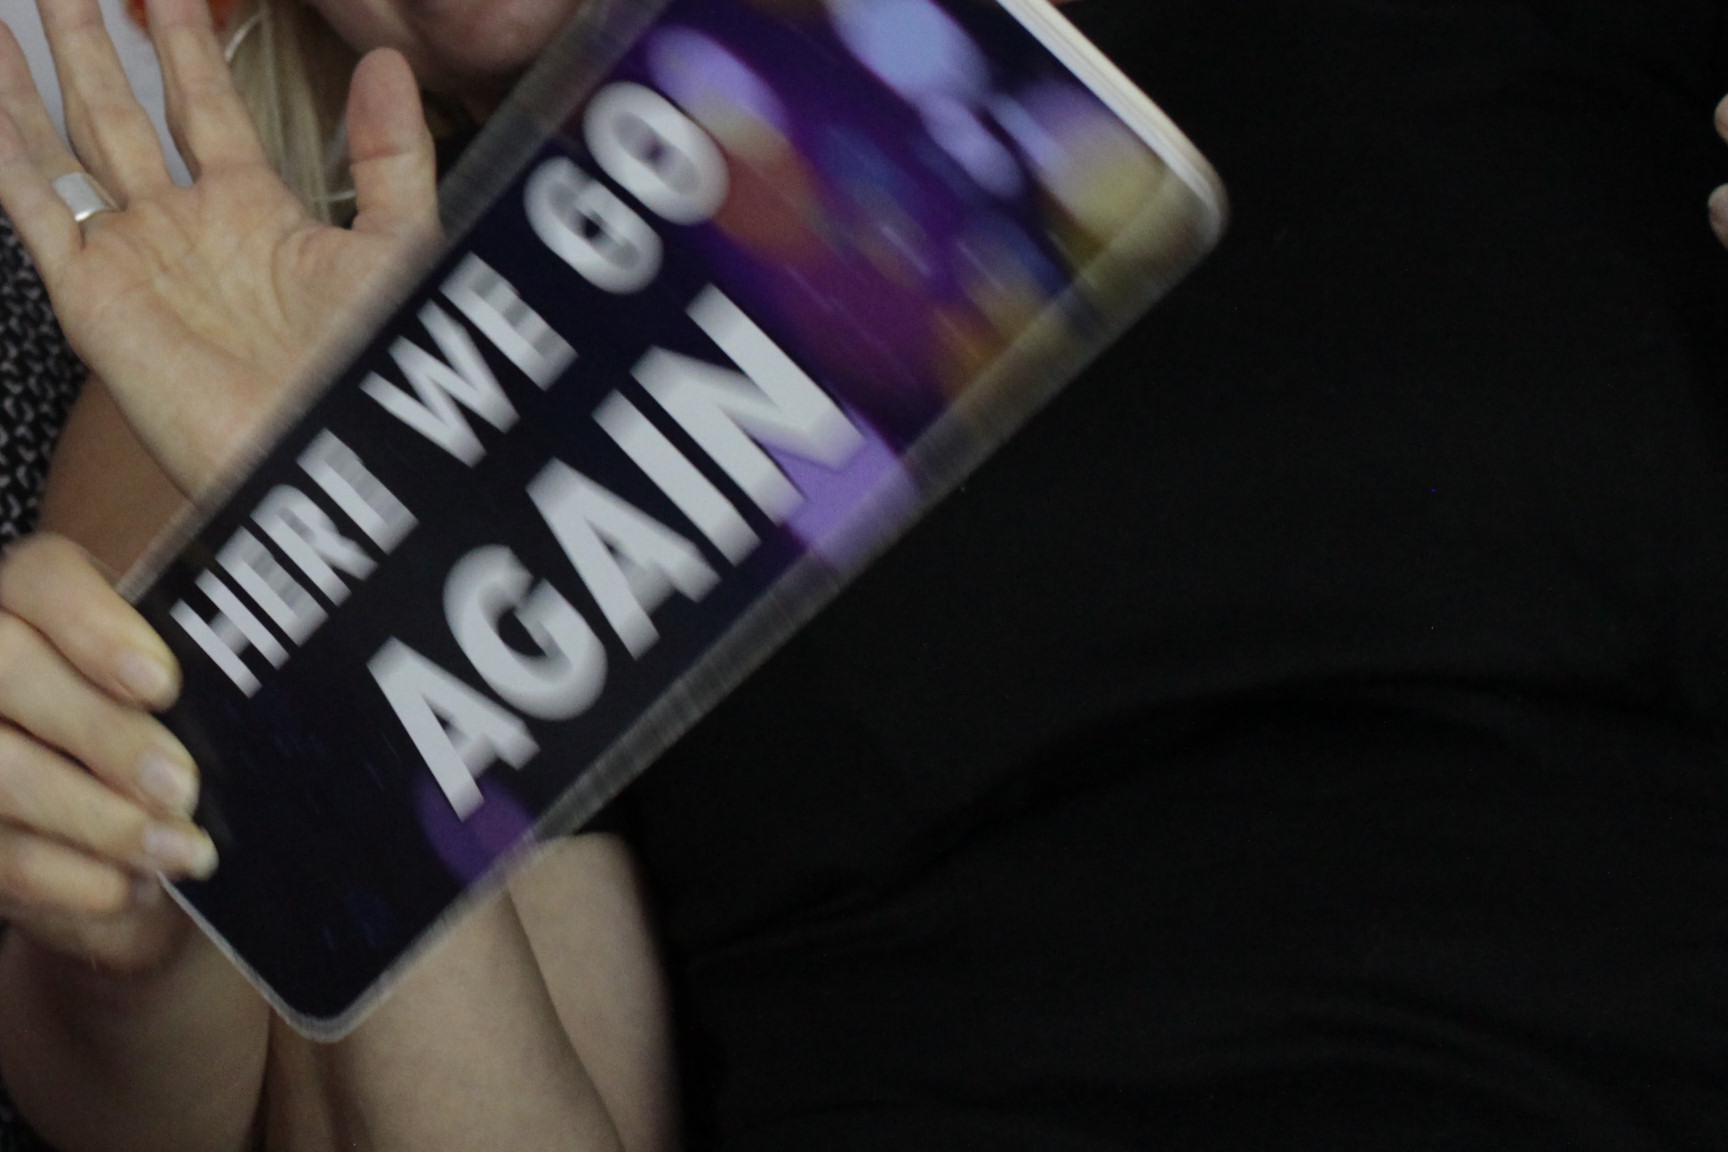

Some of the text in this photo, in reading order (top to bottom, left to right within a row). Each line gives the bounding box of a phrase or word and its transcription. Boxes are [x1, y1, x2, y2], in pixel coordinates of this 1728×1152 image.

[169, 80, 729, 699] HERE WE GO
[366, 283, 868, 822] AGAIN
